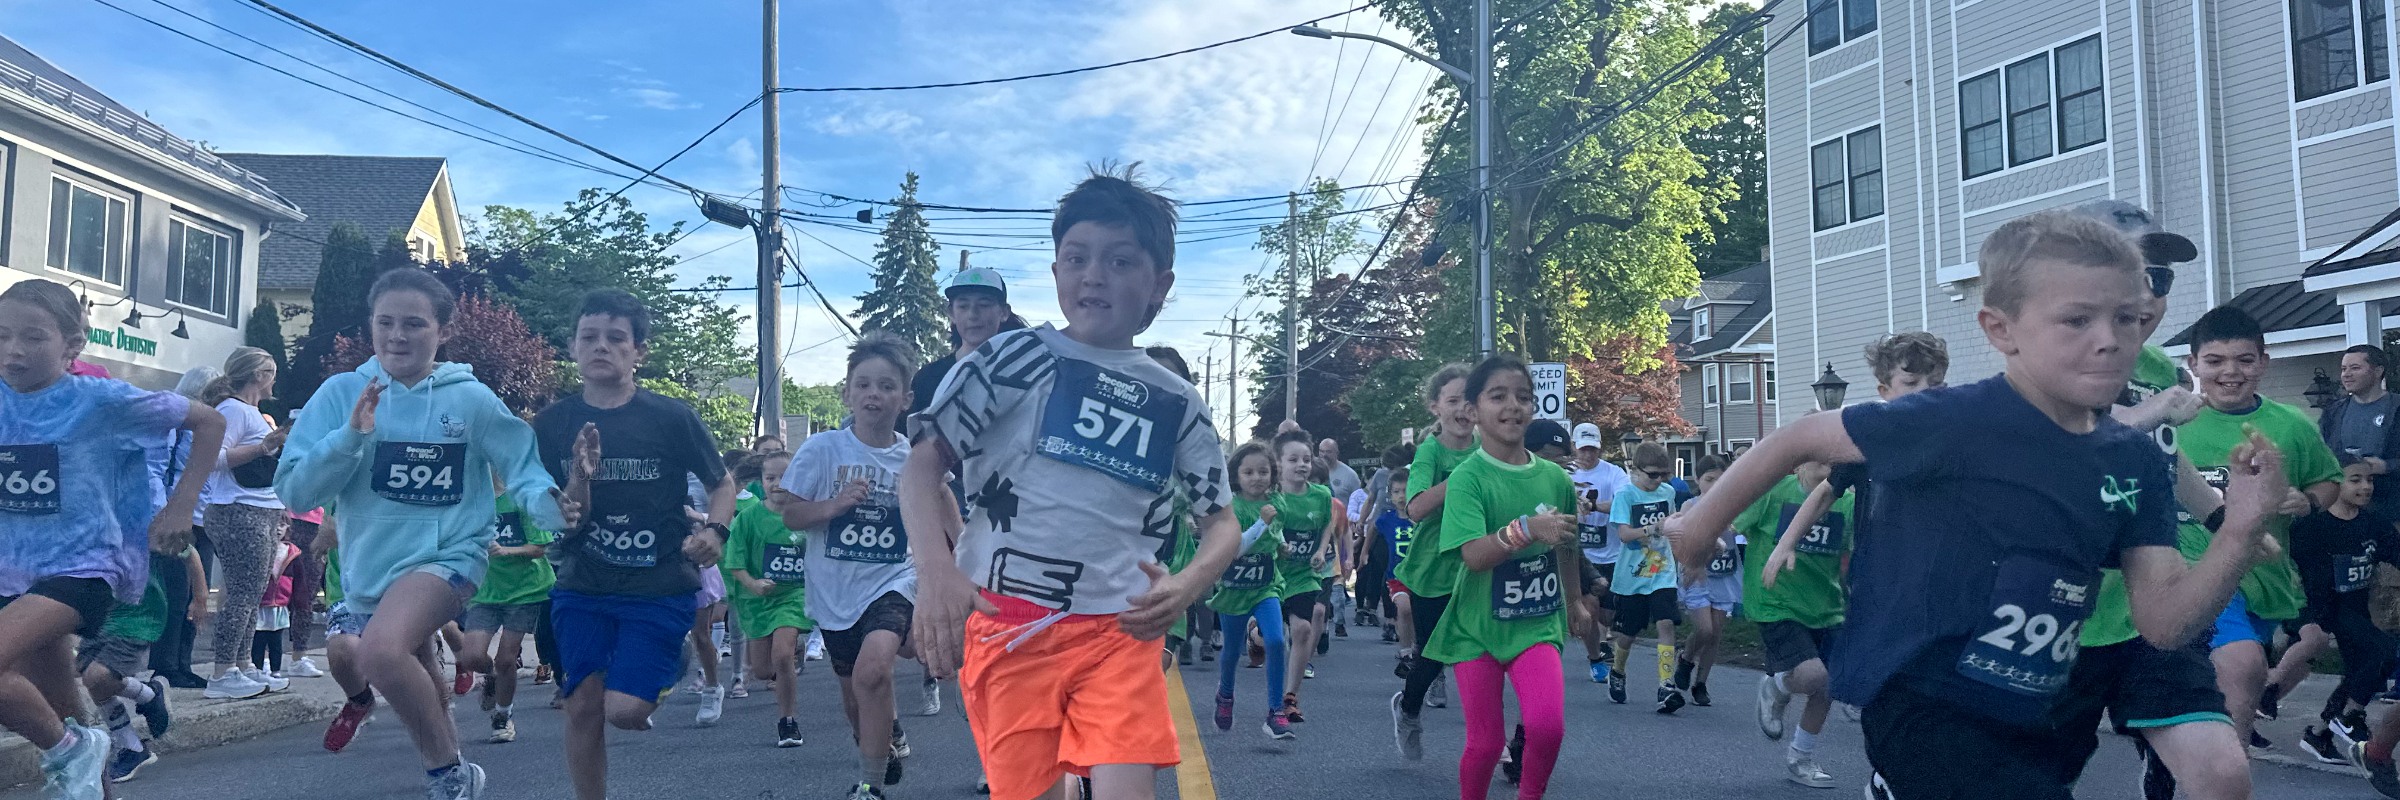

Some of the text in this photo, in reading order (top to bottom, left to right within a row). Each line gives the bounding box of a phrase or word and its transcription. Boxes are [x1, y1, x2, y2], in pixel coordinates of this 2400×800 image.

[87, 327, 115, 348] IATRIC
[1097, 372, 1136, 393] Second
[1532, 369, 1562, 378] PEED
[1113, 386, 1140, 403] Wind
[1073, 397, 1154, 459] 571
[0, 469, 56, 495] 66
[387, 463, 453, 490] 594
[587, 521, 656, 550] 2960
[840, 523, 896, 549] 686
[1804, 524, 1831, 545] 31
[1289, 540, 1315, 554] 567
[770, 556, 804, 573] 658
[1234, 565, 1264, 580] 741
[1711, 559, 1733, 571] 614
[1503, 572, 1558, 605] 540
